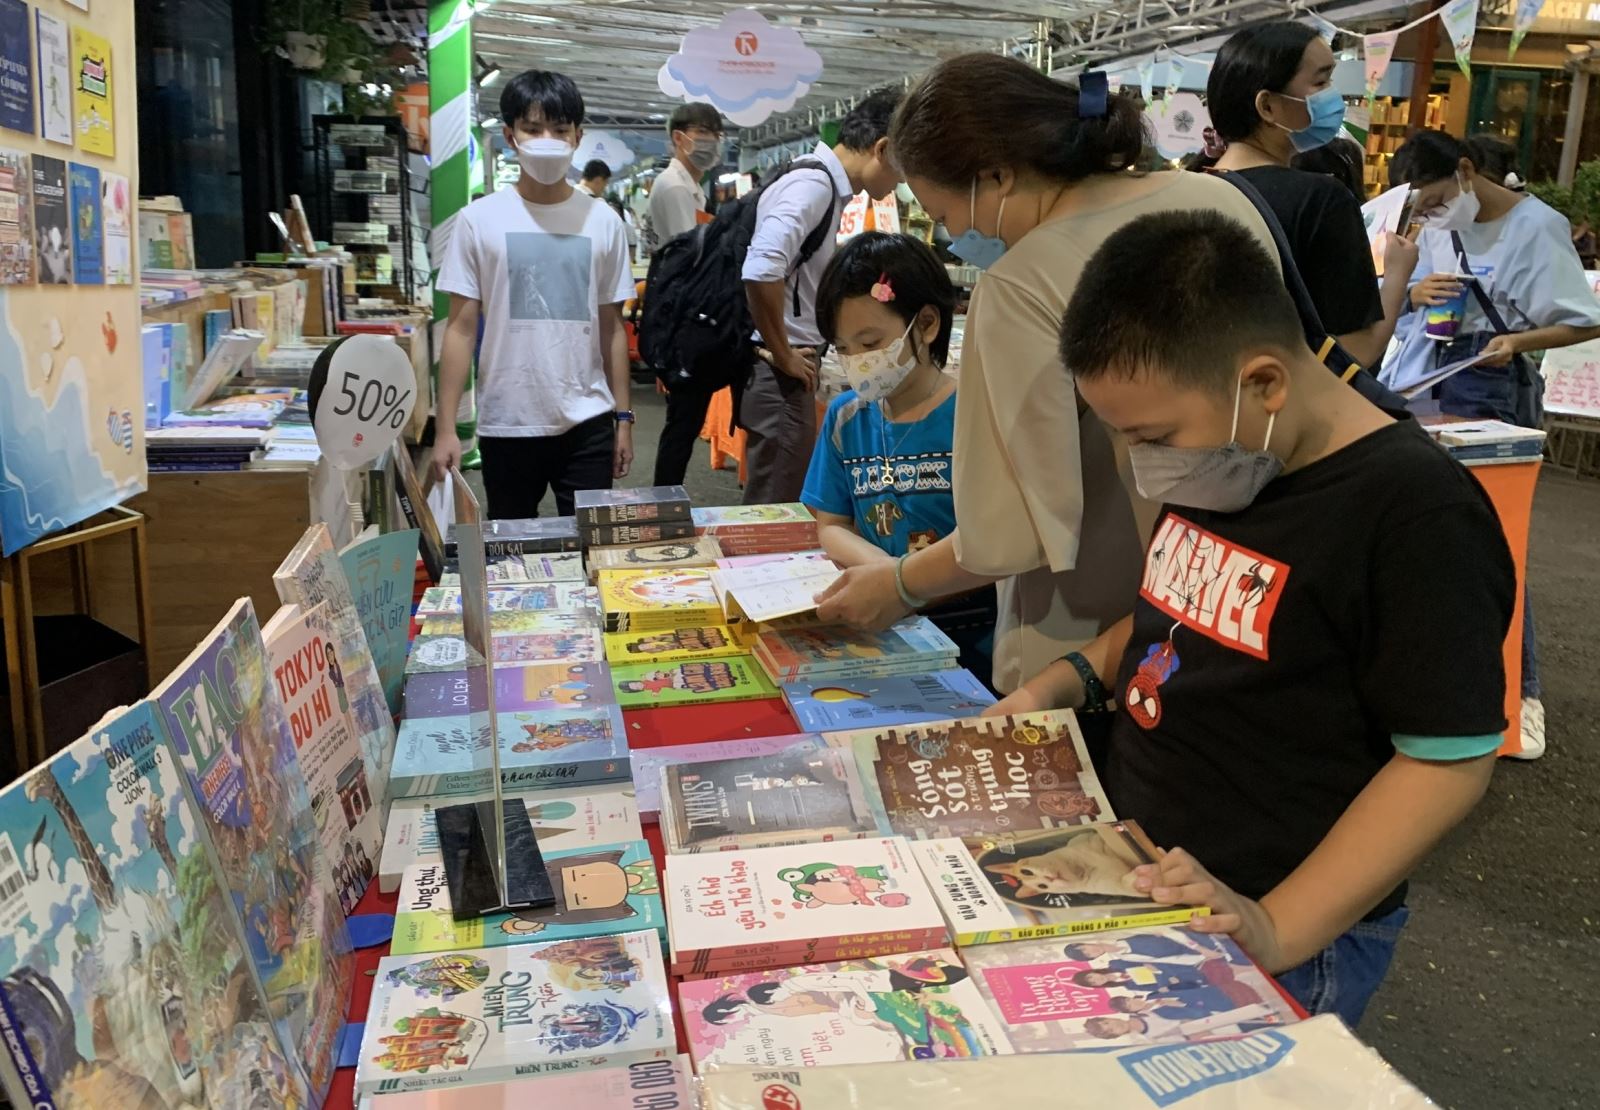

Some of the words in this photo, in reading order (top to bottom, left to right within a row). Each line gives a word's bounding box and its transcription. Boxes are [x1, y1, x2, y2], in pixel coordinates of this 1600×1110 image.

[333, 371, 411, 430] 50%
[1142, 517, 1278, 652] MARVEL
[274, 636, 326, 704] TOKYO
[170, 625, 256, 780] EAG
[289, 710, 312, 750] DU
[311, 673, 332, 729] HÍ
[116, 767, 142, 794] COLOR
[972, 748, 1010, 814] trung
[1003, 752, 1033, 800] học
[681, 779, 721, 831] TWINS
[723, 860, 749, 884] khạo
[411, 886, 440, 911] Ung
[698, 898, 727, 918] Ếch
[727, 886, 752, 908] Thỏ
[743, 909, 767, 930] yêu
[499, 971, 533, 1033] TRUNG
[812, 1030, 833, 1053] biệt
[831, 1019, 844, 1037] em
[543, 1060, 579, 1073] TRUNG
[801, 1047, 817, 1067] ạm
[1132, 1029, 1282, 1097] DORAEMON
